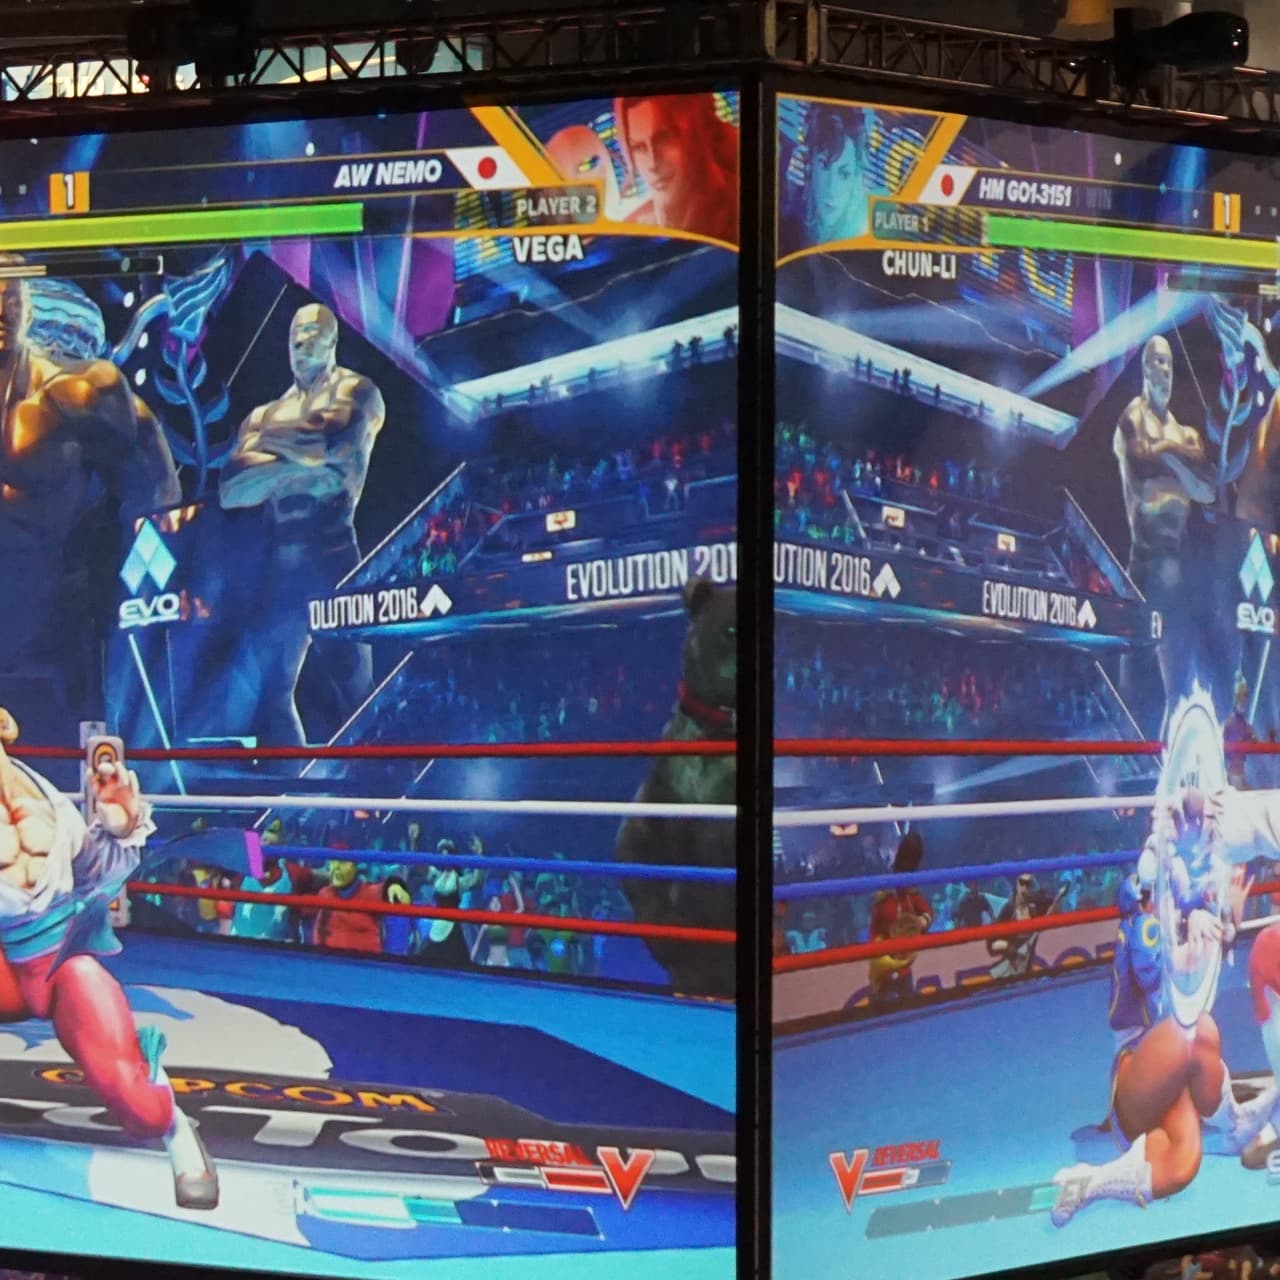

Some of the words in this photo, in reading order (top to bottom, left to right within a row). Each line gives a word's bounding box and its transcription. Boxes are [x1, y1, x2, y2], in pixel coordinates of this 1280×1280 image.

[63, 173, 76, 208] 1
[334, 164, 376, 189] AW
[376, 159, 443, 186] NEMO
[979, 176, 1005, 201] HM
[517, 197, 582, 218] PLAYER
[584, 195, 597, 214] 2
[875, 212, 921, 234] PLAYER
[512, 234, 584, 264] VEGA
[883, 249, 957, 280] CHUN-LI
[566, 550, 689, 600] EVOLUTION
[830, 554, 871, 596] 2016
[120, 592, 180, 622] EVO
[378, 587, 418, 622] 2016
[983, 580, 1048, 622] EVOLUTION
[1049, 593, 1077, 624] 2016
[1237, 602, 1275, 628] EVO
[36, 1065, 442, 1114] CPCOM
[597, 1145, 656, 1212] V
[829, 1148, 869, 1215] V
[872, 1139, 942, 1165] REVERSAL
